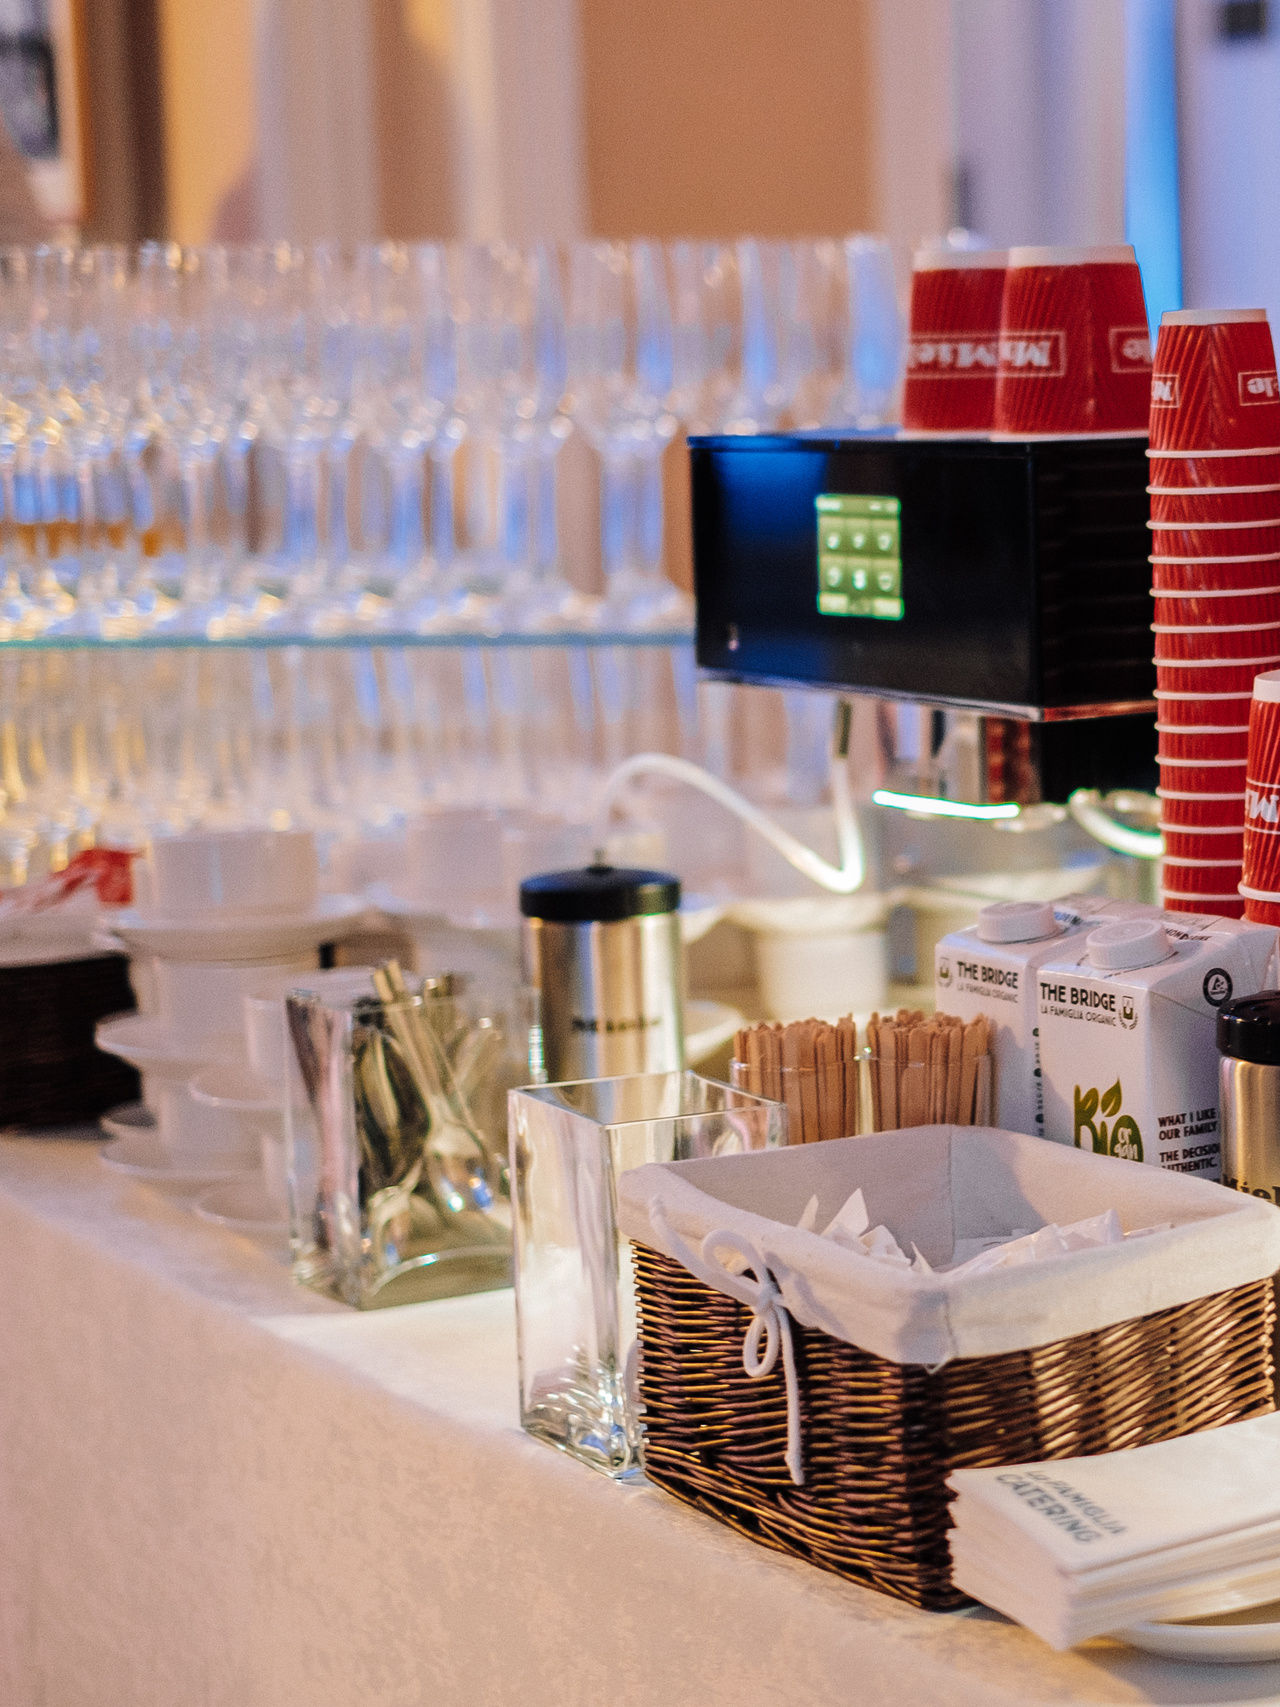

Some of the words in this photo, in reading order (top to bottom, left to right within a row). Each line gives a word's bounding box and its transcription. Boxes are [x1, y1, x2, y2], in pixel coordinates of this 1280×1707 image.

[957, 960, 978, 981] THE
[981, 965, 1018, 989] BRIDGE
[1040, 982, 1066, 1003] THE
[1071, 987, 1116, 1012] BRIDGE
[1157, 1113, 1187, 1127] WHAT
[1196, 1107, 1217, 1121] LIKE
[1158, 1128, 1181, 1141] OUR
[1183, 1120, 1218, 1137] FAMILY
[1159, 1150, 1179, 1163] THE
[995, 1473, 1102, 1542] CATERING
